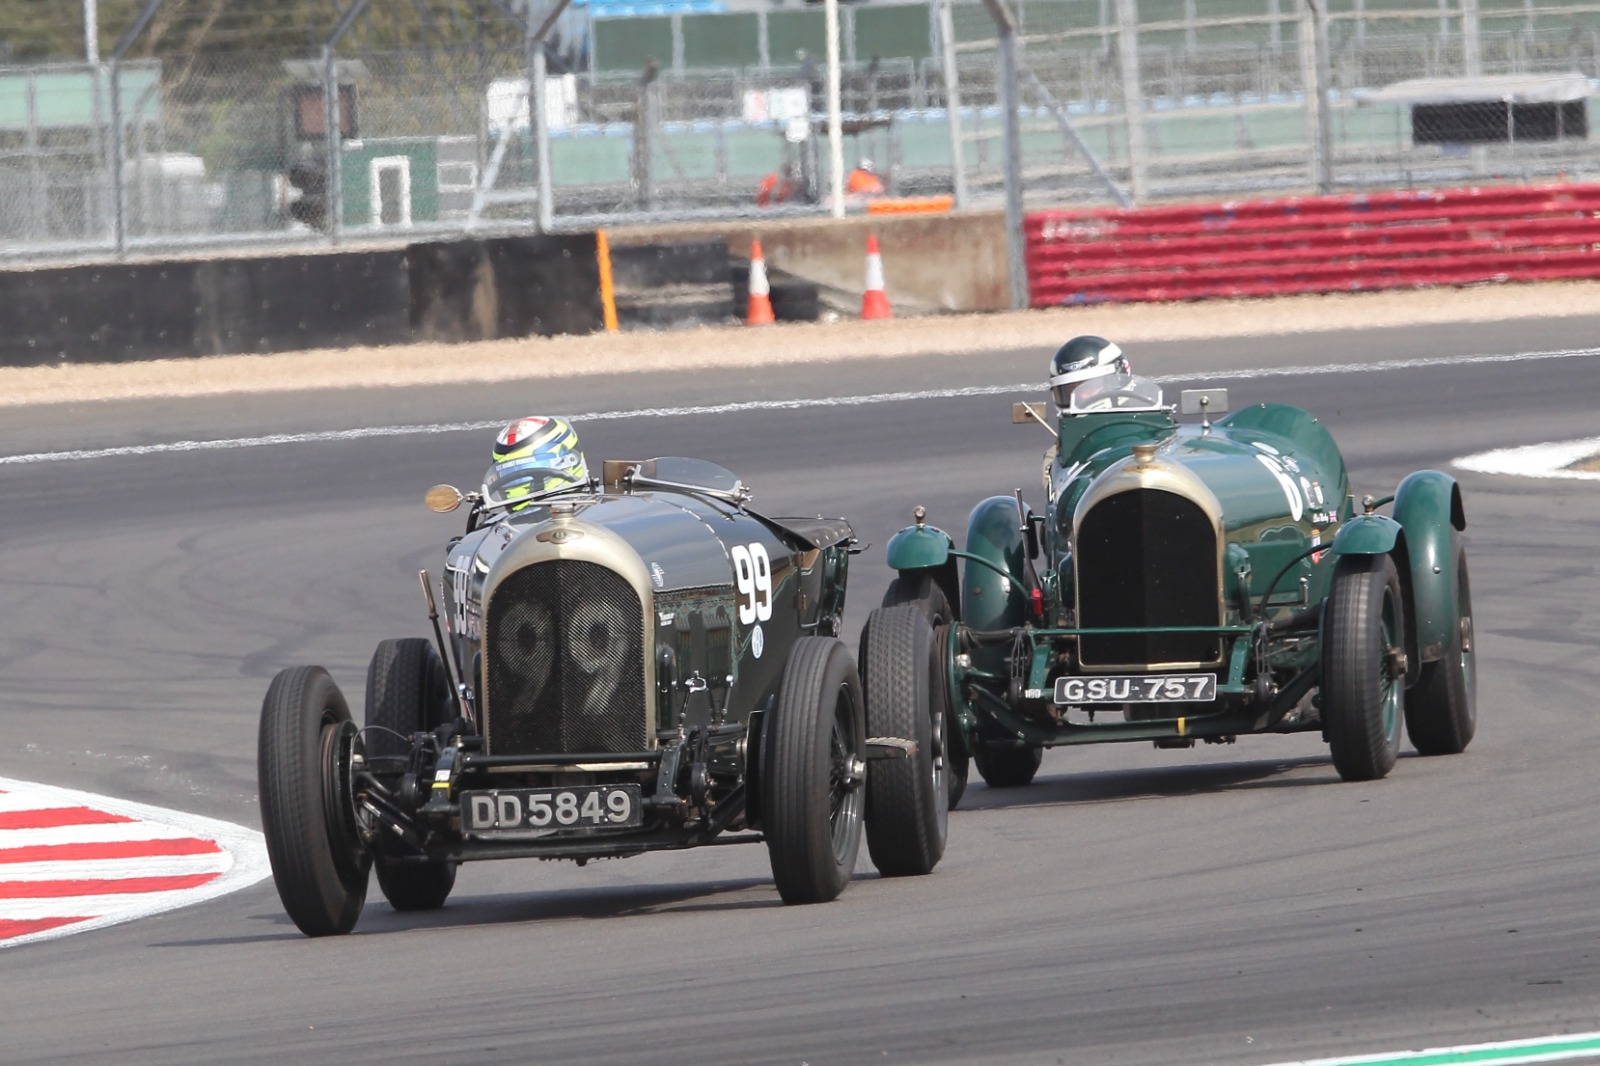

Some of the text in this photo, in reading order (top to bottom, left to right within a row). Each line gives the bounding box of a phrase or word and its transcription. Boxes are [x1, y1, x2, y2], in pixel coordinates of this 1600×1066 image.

[731, 542, 773, 625] 99
[497, 597, 629, 716] 99
[1063, 679, 1131, 700] GSU
[1144, 677, 1209, 699] 757
[471, 790, 631, 829] DD 5849
